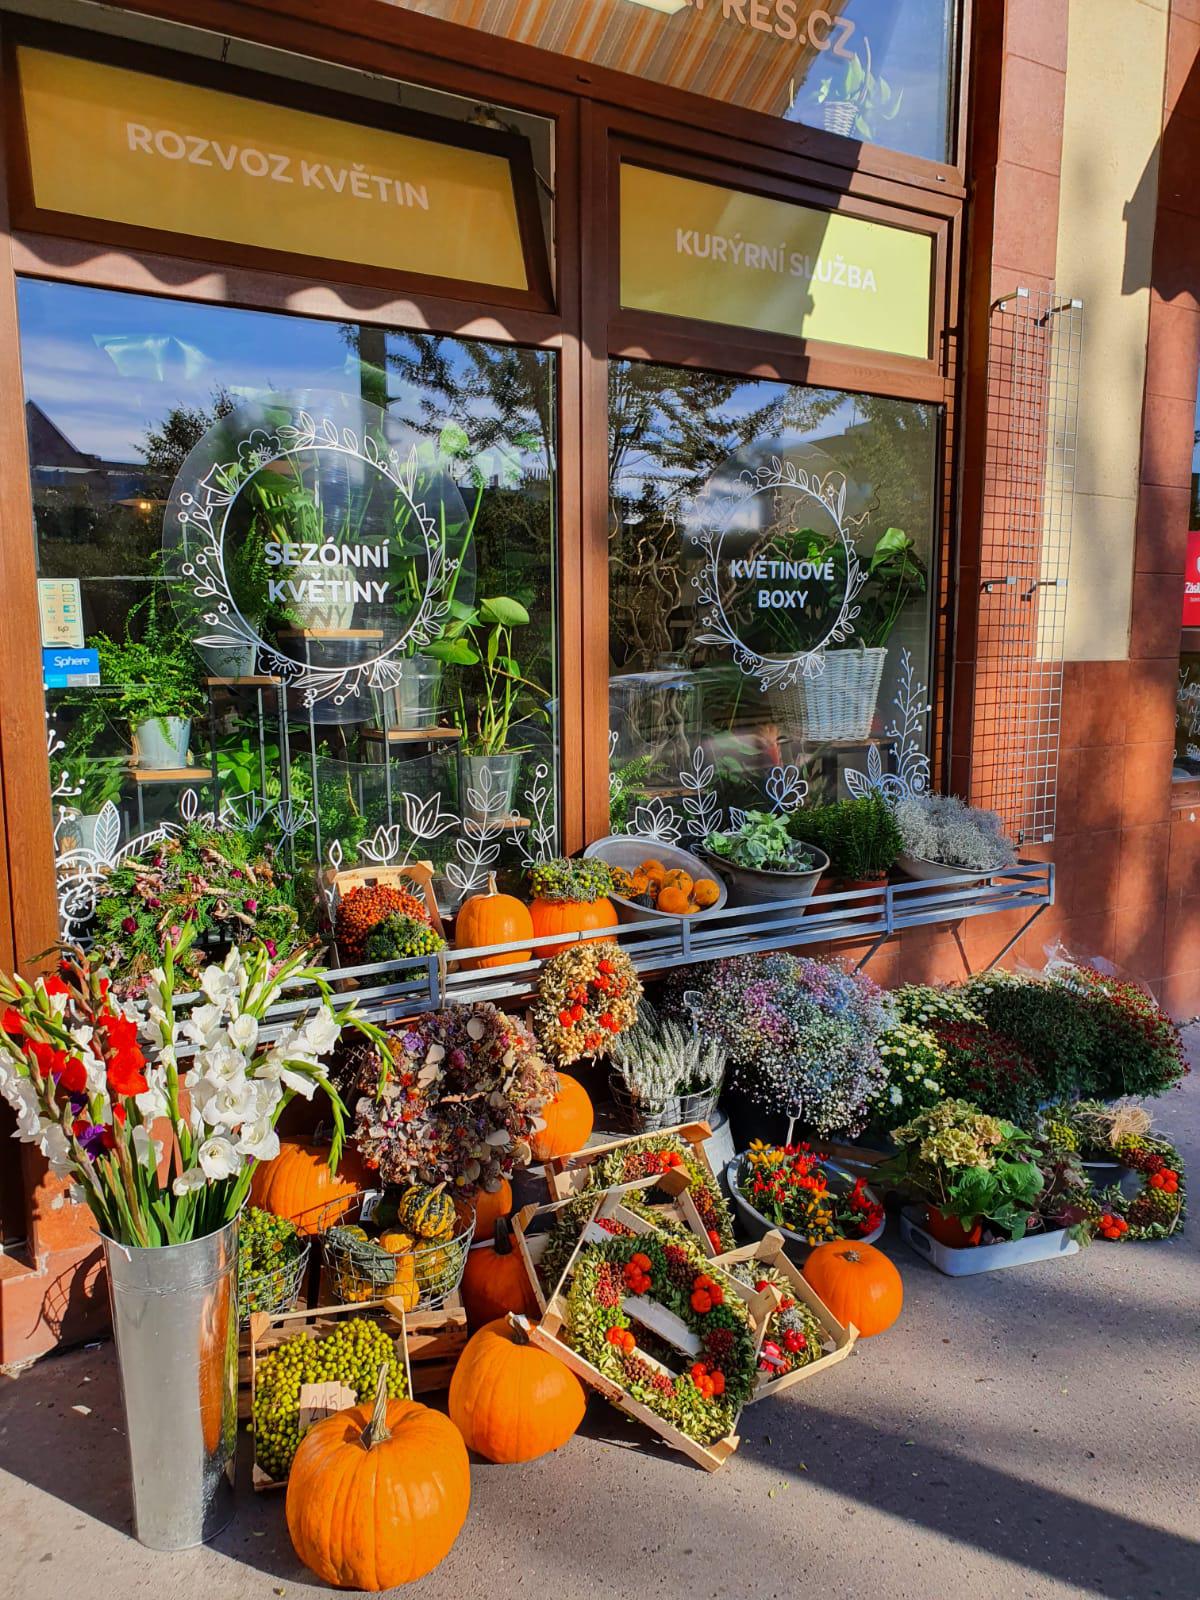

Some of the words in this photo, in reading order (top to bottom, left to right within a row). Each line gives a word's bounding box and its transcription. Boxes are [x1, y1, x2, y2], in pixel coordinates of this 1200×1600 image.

[126, 122, 294, 183] ROZVOZ
[300, 163, 430, 210] KVĚTIN
[676, 228, 786, 273] KURÝRNÍ
[790, 252, 877, 293] SLUŽBA
[264, 536, 391, 568] SEZÓNNÍ
[730, 555, 835, 581] KVĚTINOVÉ
[267, 572, 391, 604] KVĚTINY
[758, 589, 809, 609] BOXY
[53, 655, 91, 668] Sphere
